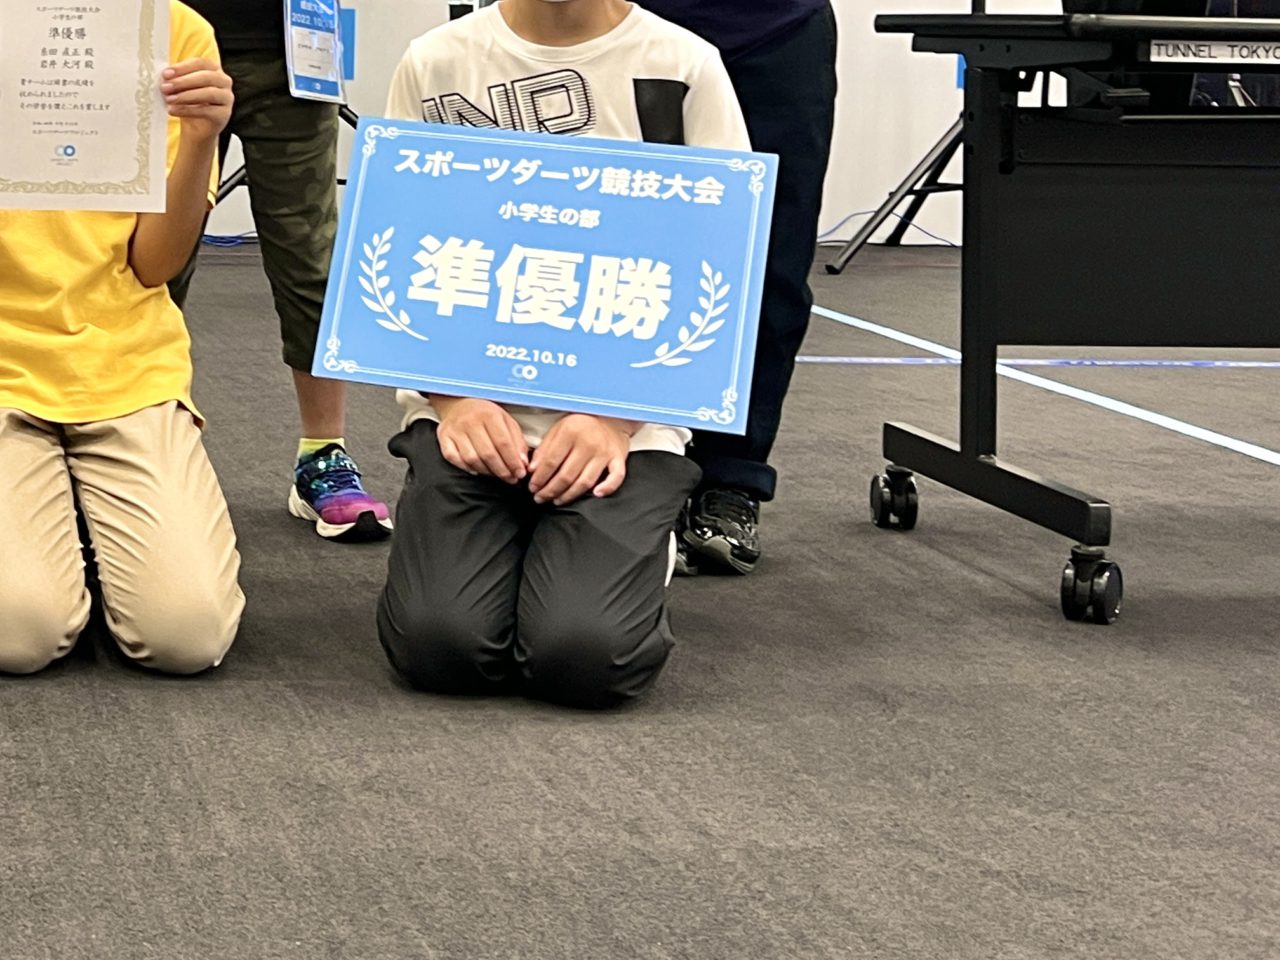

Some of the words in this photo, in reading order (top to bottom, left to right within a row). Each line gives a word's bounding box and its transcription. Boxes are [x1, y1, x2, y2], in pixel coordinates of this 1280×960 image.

[48, 27, 87, 40] 準優勝
[1153, 43, 1217, 58] TUNNEL
[394, 149, 725, 205] スポーツダーツ競技大会
[498, 200, 601, 229] 小学生の部
[407, 234, 671, 340] 準優勝
[485, 344, 577, 368] 2022.10.16
